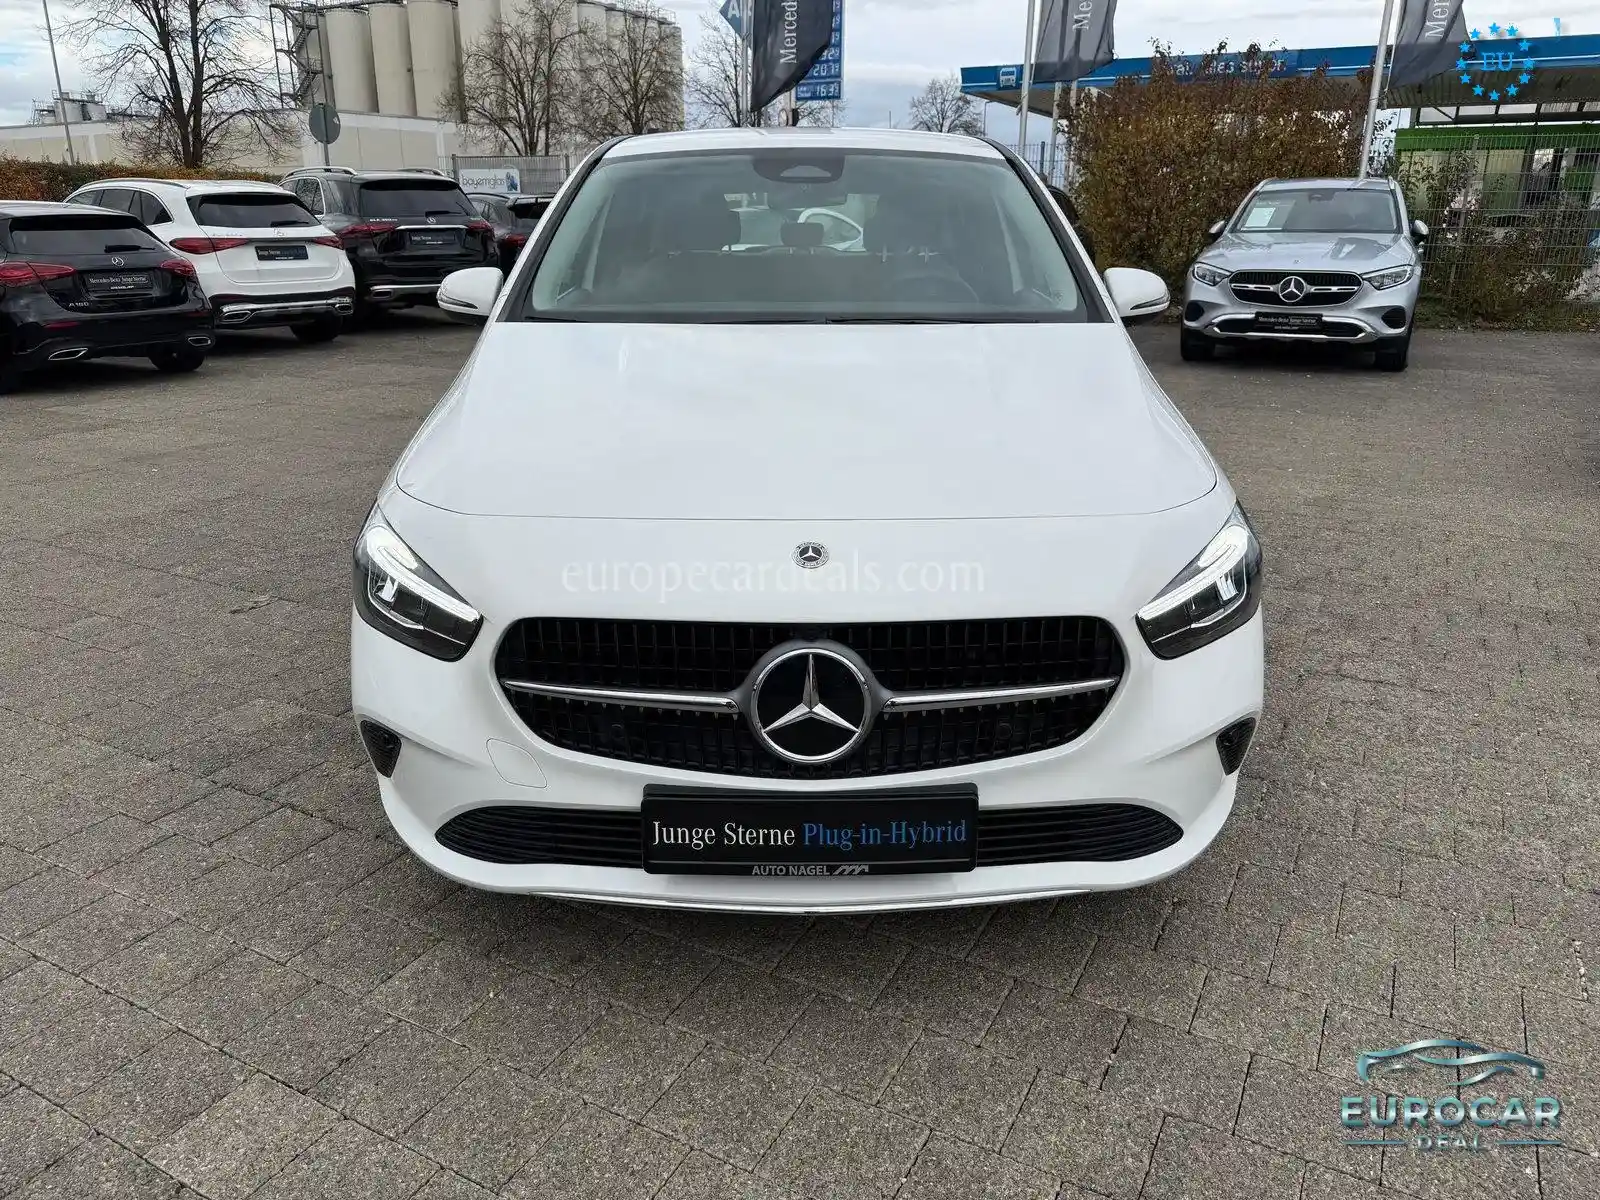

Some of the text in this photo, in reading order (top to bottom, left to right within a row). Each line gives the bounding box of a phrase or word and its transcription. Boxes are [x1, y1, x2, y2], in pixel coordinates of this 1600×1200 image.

[652, 819, 968, 850] Junge Sterne Plug-in-Hybrid
[751, 864, 831, 877] AUTO NAGEL
